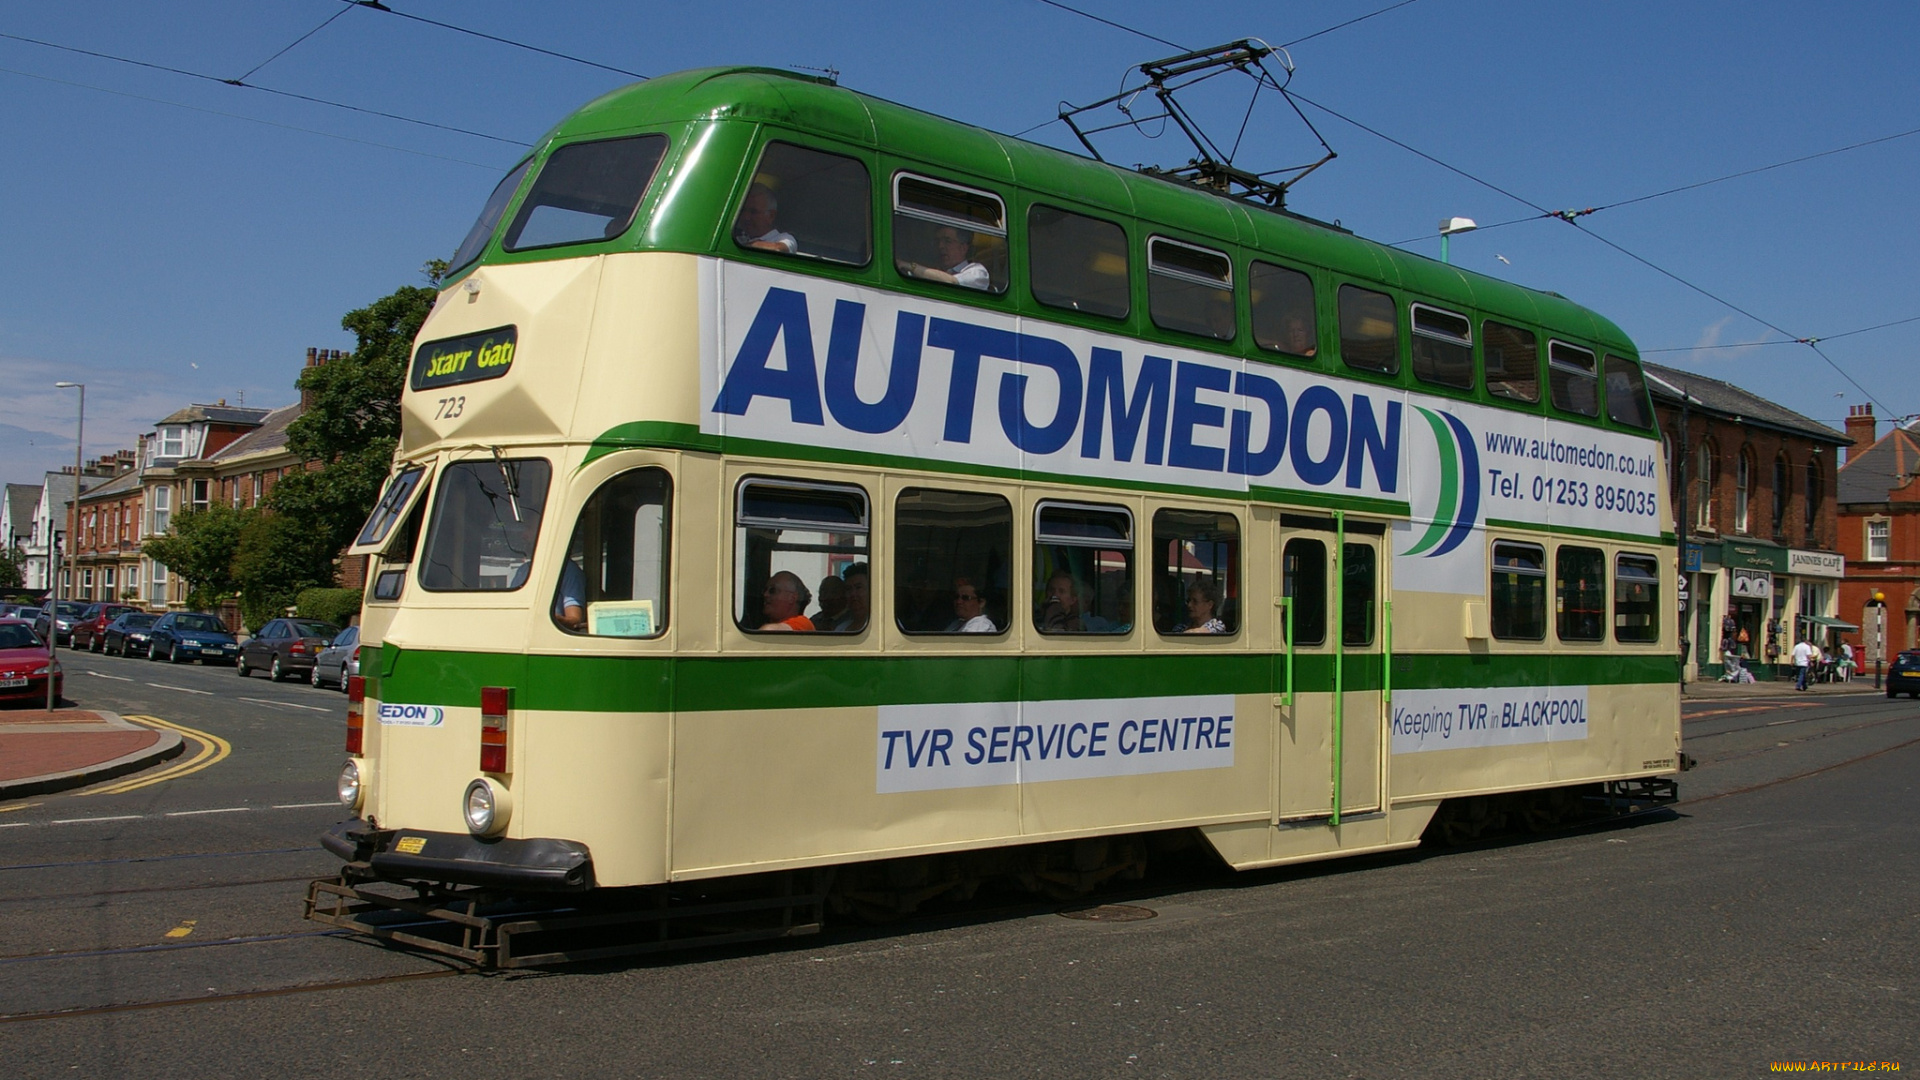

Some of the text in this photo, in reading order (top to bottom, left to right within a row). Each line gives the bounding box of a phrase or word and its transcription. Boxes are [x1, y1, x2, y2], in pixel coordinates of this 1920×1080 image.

[426, 348, 473, 378] Starr
[434, 396, 466, 421] 723
[711, 286, 1402, 494] AUTOMEDON
[1485, 431, 1655, 479] www.automedon.co.uk
[1488, 469, 1656, 516] Tel. 01253 895035
[881, 715, 1234, 770] TVR SERVICE CENTRE
[1392, 699, 1587, 740] Keeping TVR in BLACKPOOL
